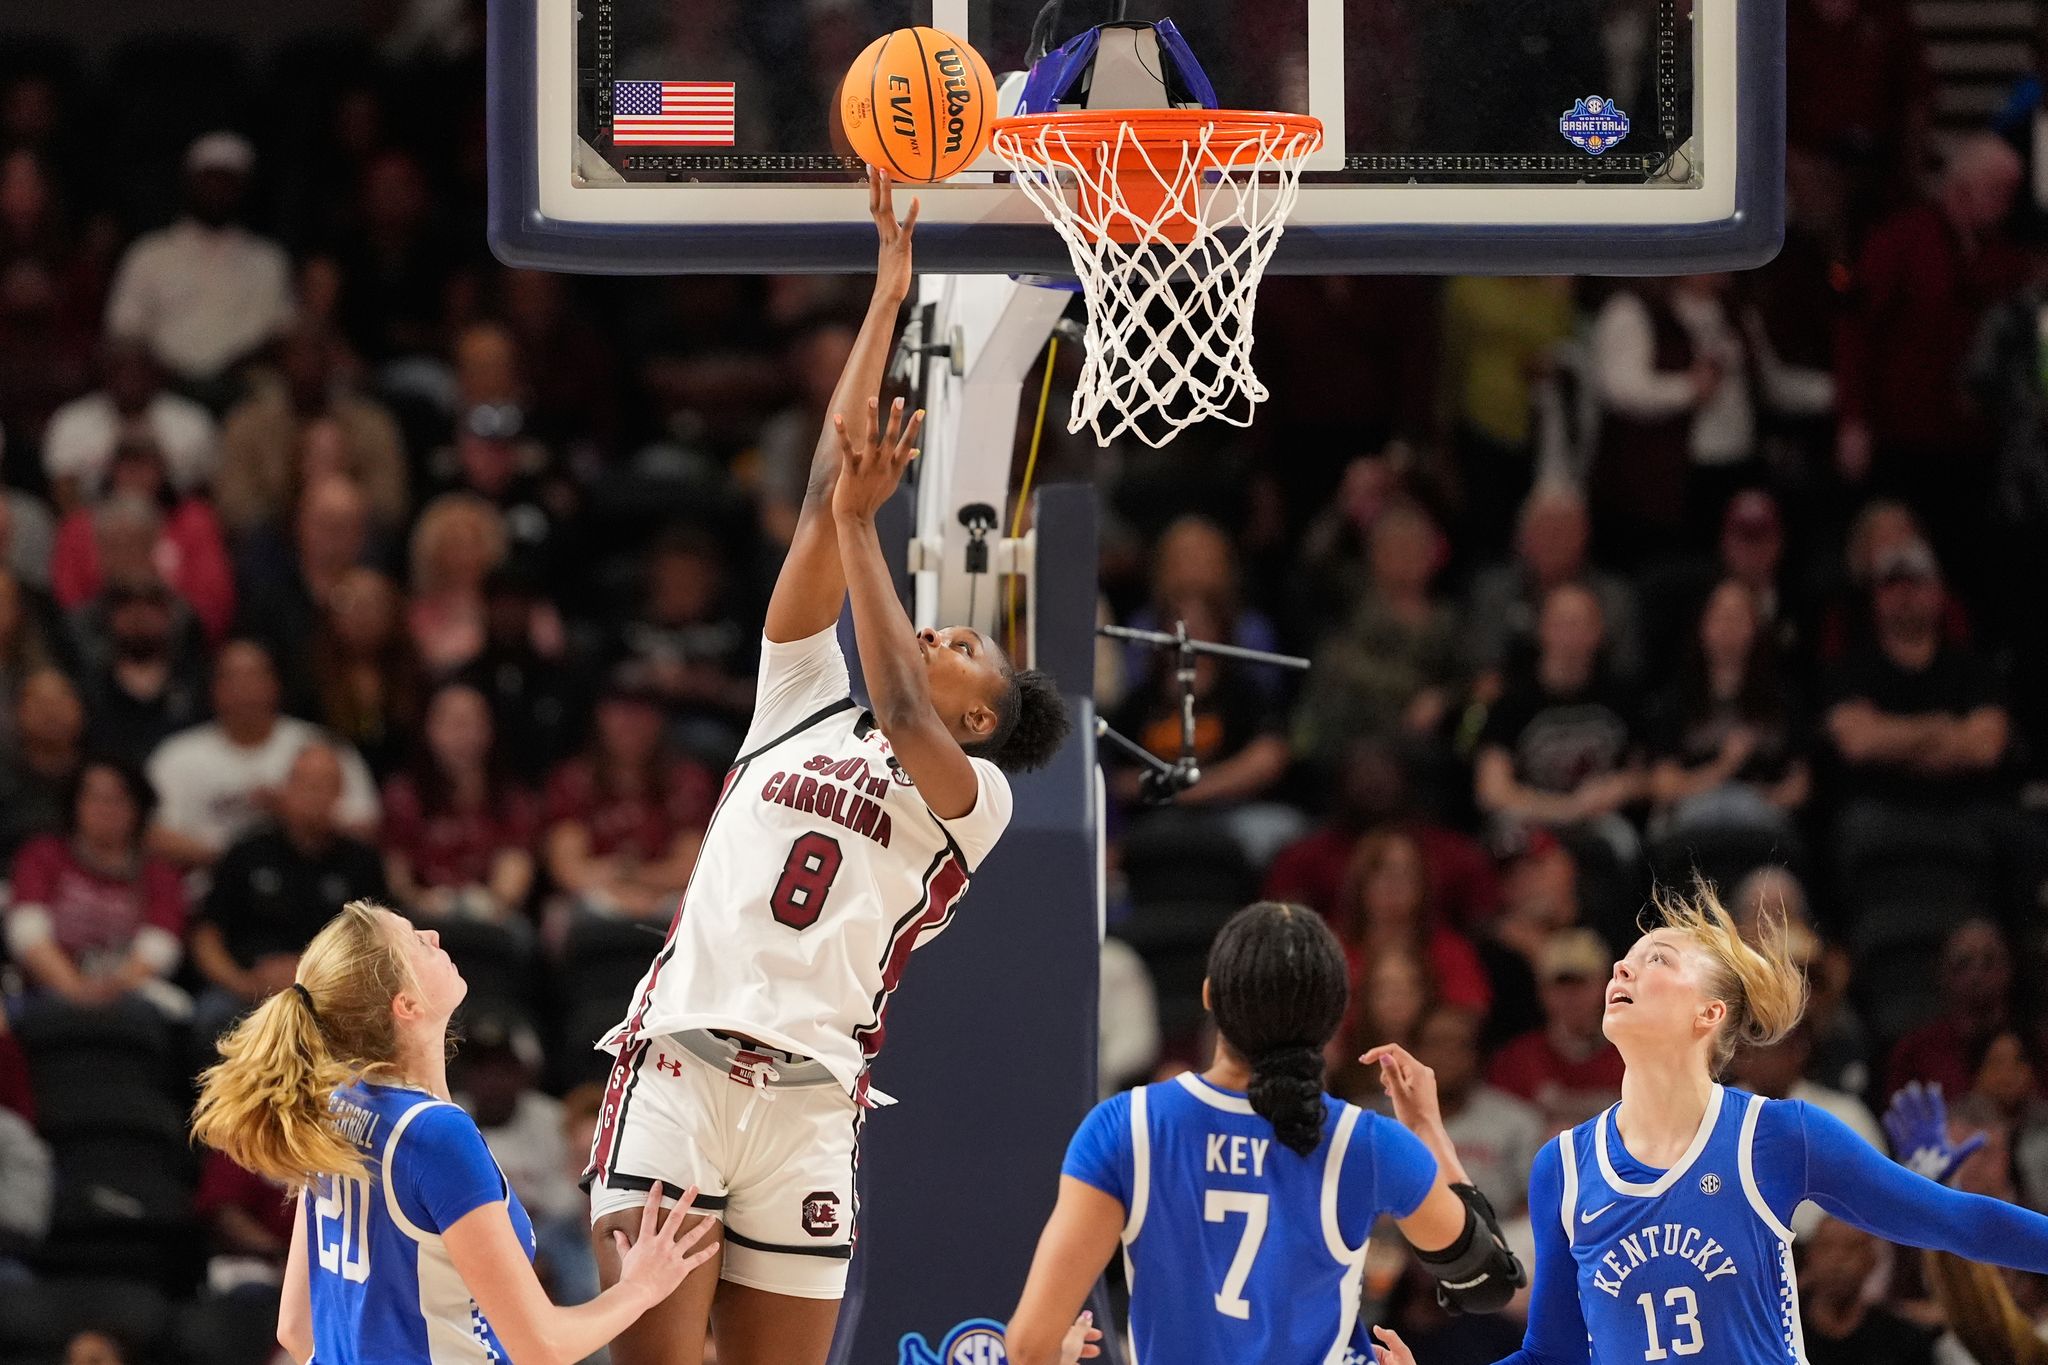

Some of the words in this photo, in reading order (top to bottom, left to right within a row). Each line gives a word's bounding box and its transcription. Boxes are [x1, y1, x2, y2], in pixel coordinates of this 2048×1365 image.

[889, 74, 917, 137] EVO
[934, 48, 970, 153] Wilson
[1562, 121, 1627, 131] BASKETBALL
[761, 771, 892, 849] CAROLINA
[803, 754, 890, 800] SOUTH
[770, 831, 843, 931] 8
[1205, 1133, 1269, 1177] KEY
[1701, 1175, 1719, 1192] SEC
[314, 1171, 371, 1285] 20
[1203, 1189, 1269, 1320] 7
[1593, 1223, 1738, 1298] KENTUCKY
[1636, 1285, 1705, 1362] 13
